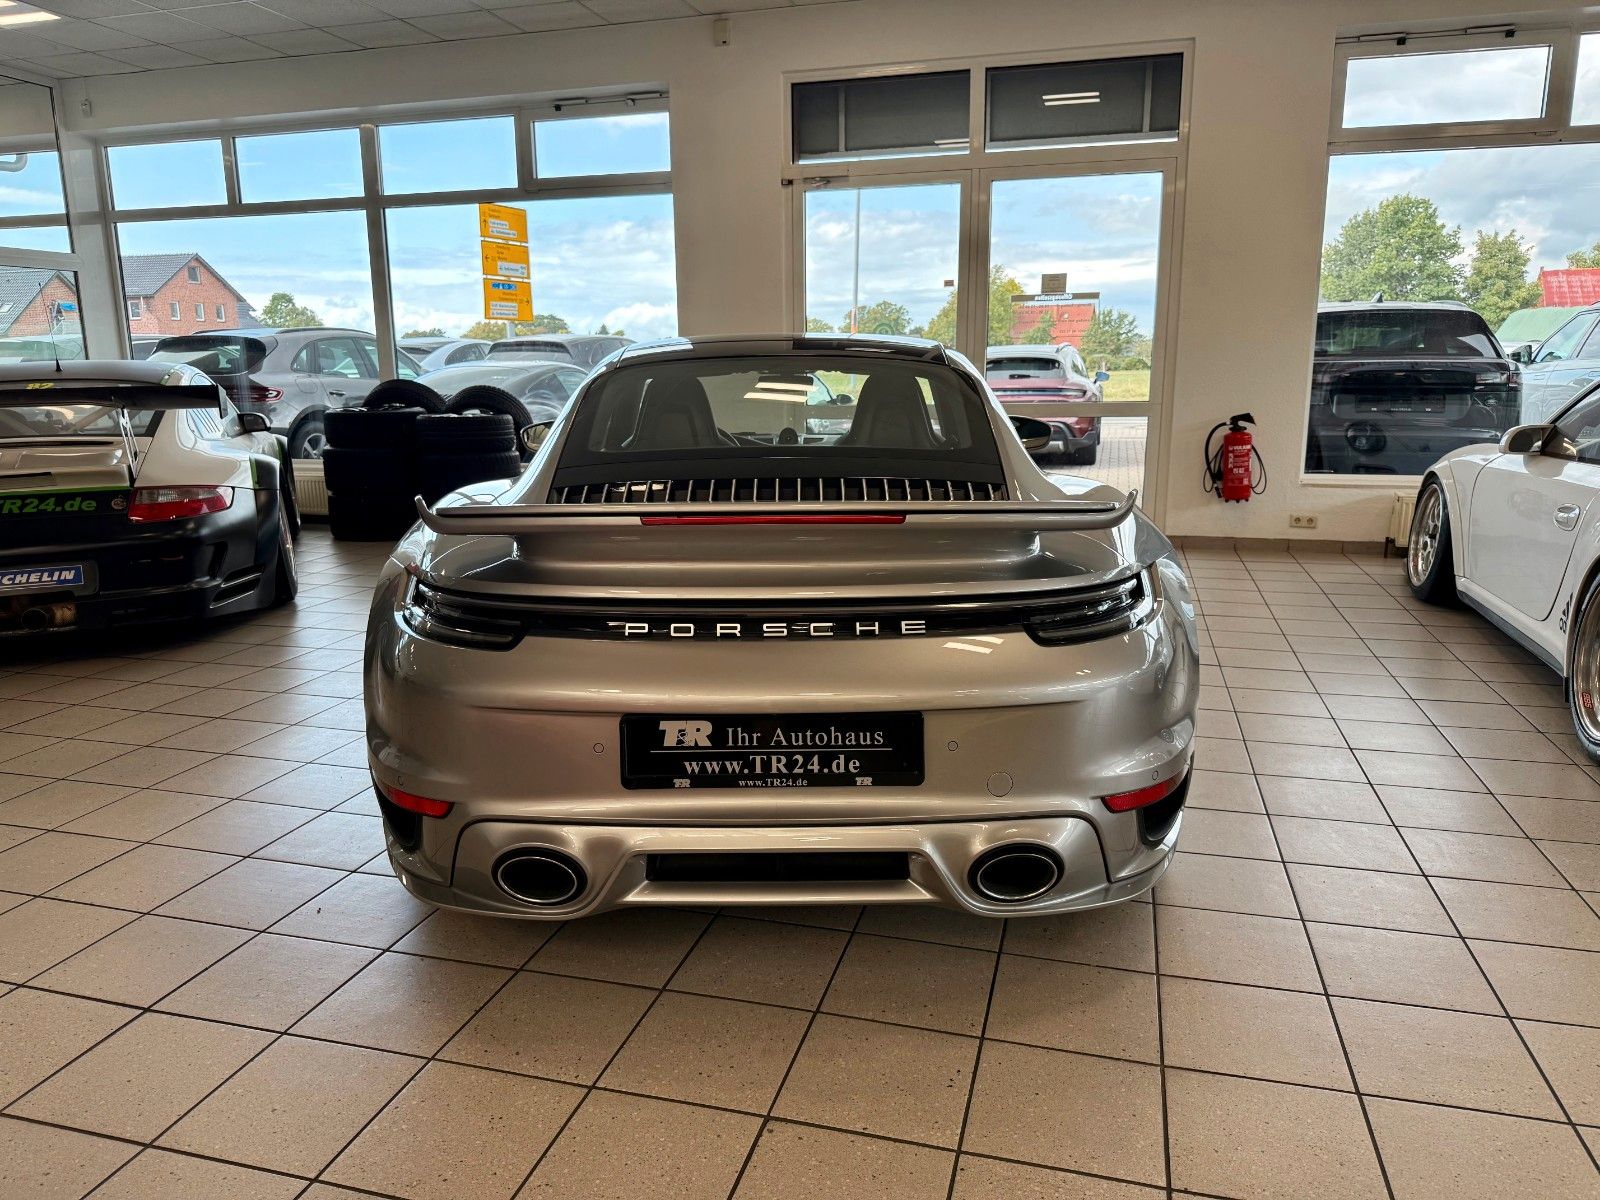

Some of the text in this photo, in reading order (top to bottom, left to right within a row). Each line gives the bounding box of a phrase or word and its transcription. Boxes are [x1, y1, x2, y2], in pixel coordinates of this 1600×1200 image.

[0, 570, 76, 585] CHELIN
[624, 620, 927, 637] PORSCHE
[726, 727, 761, 747] Ihr
[770, 726, 884, 746] Autohaus
[684, 754, 861, 775] www.TR24.de
[738, 777, 808, 787] www.TR24.de
